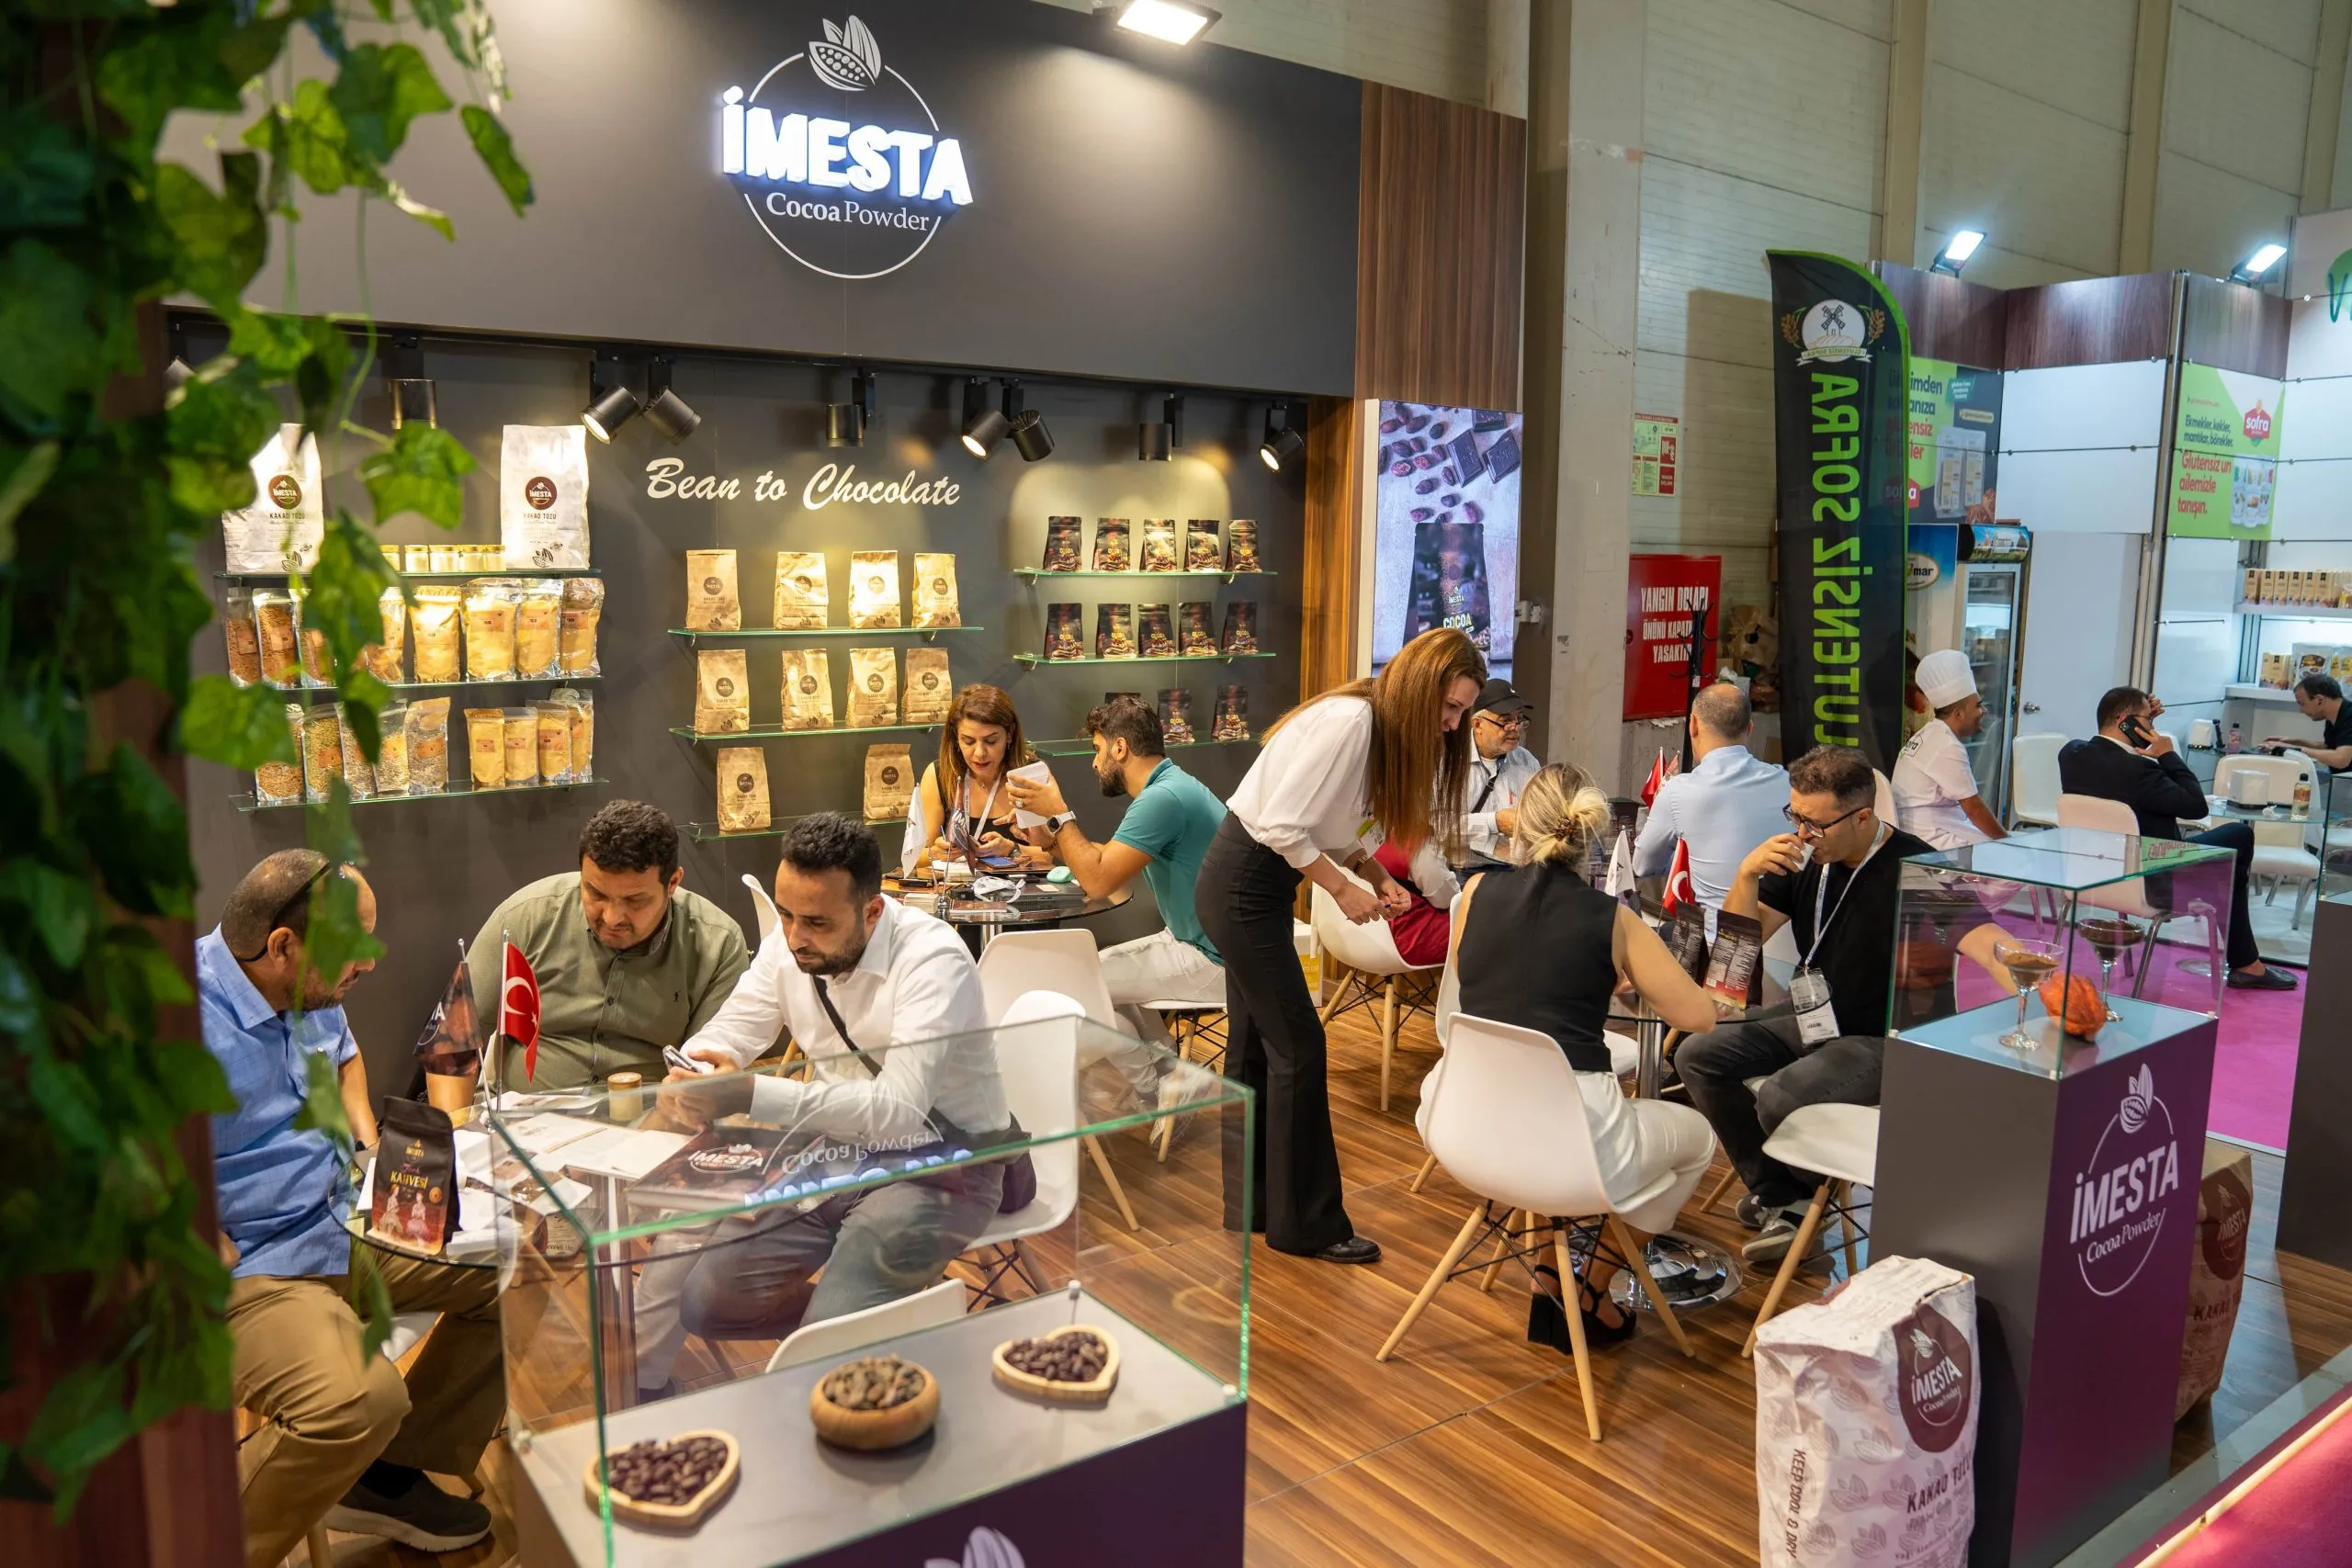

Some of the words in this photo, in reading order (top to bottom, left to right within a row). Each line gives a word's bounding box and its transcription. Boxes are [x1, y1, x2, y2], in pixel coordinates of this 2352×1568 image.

[766, 192, 841, 222] Cocoa
[843, 200, 930, 231] Powder
[2246, 415, 2268, 431] sofra
[2181, 449, 2220, 472] Glutensiz
[2221, 460, 2232, 474] un
[645, 457, 741, 500] Bean
[753, 470, 787, 502] to
[803, 463, 960, 511] Chocolate
[2179, 473, 2216, 493] ailemizle
[1641, 587, 1675, 613] YANGIN
[1443, 613, 1472, 629] COCOA
[1643, 619, 1667, 640] ÖNÜNÜ
[2086, 1233, 2121, 1263] Cocoa
[2121, 1211, 2161, 1245] Powder
[1791, 1449, 1806, 1483] KEEP
[1789, 1483, 1803, 1515] COOL
[1907, 1473, 1949, 1514] KAKAO
[1785, 1531, 1798, 1559] DRY
